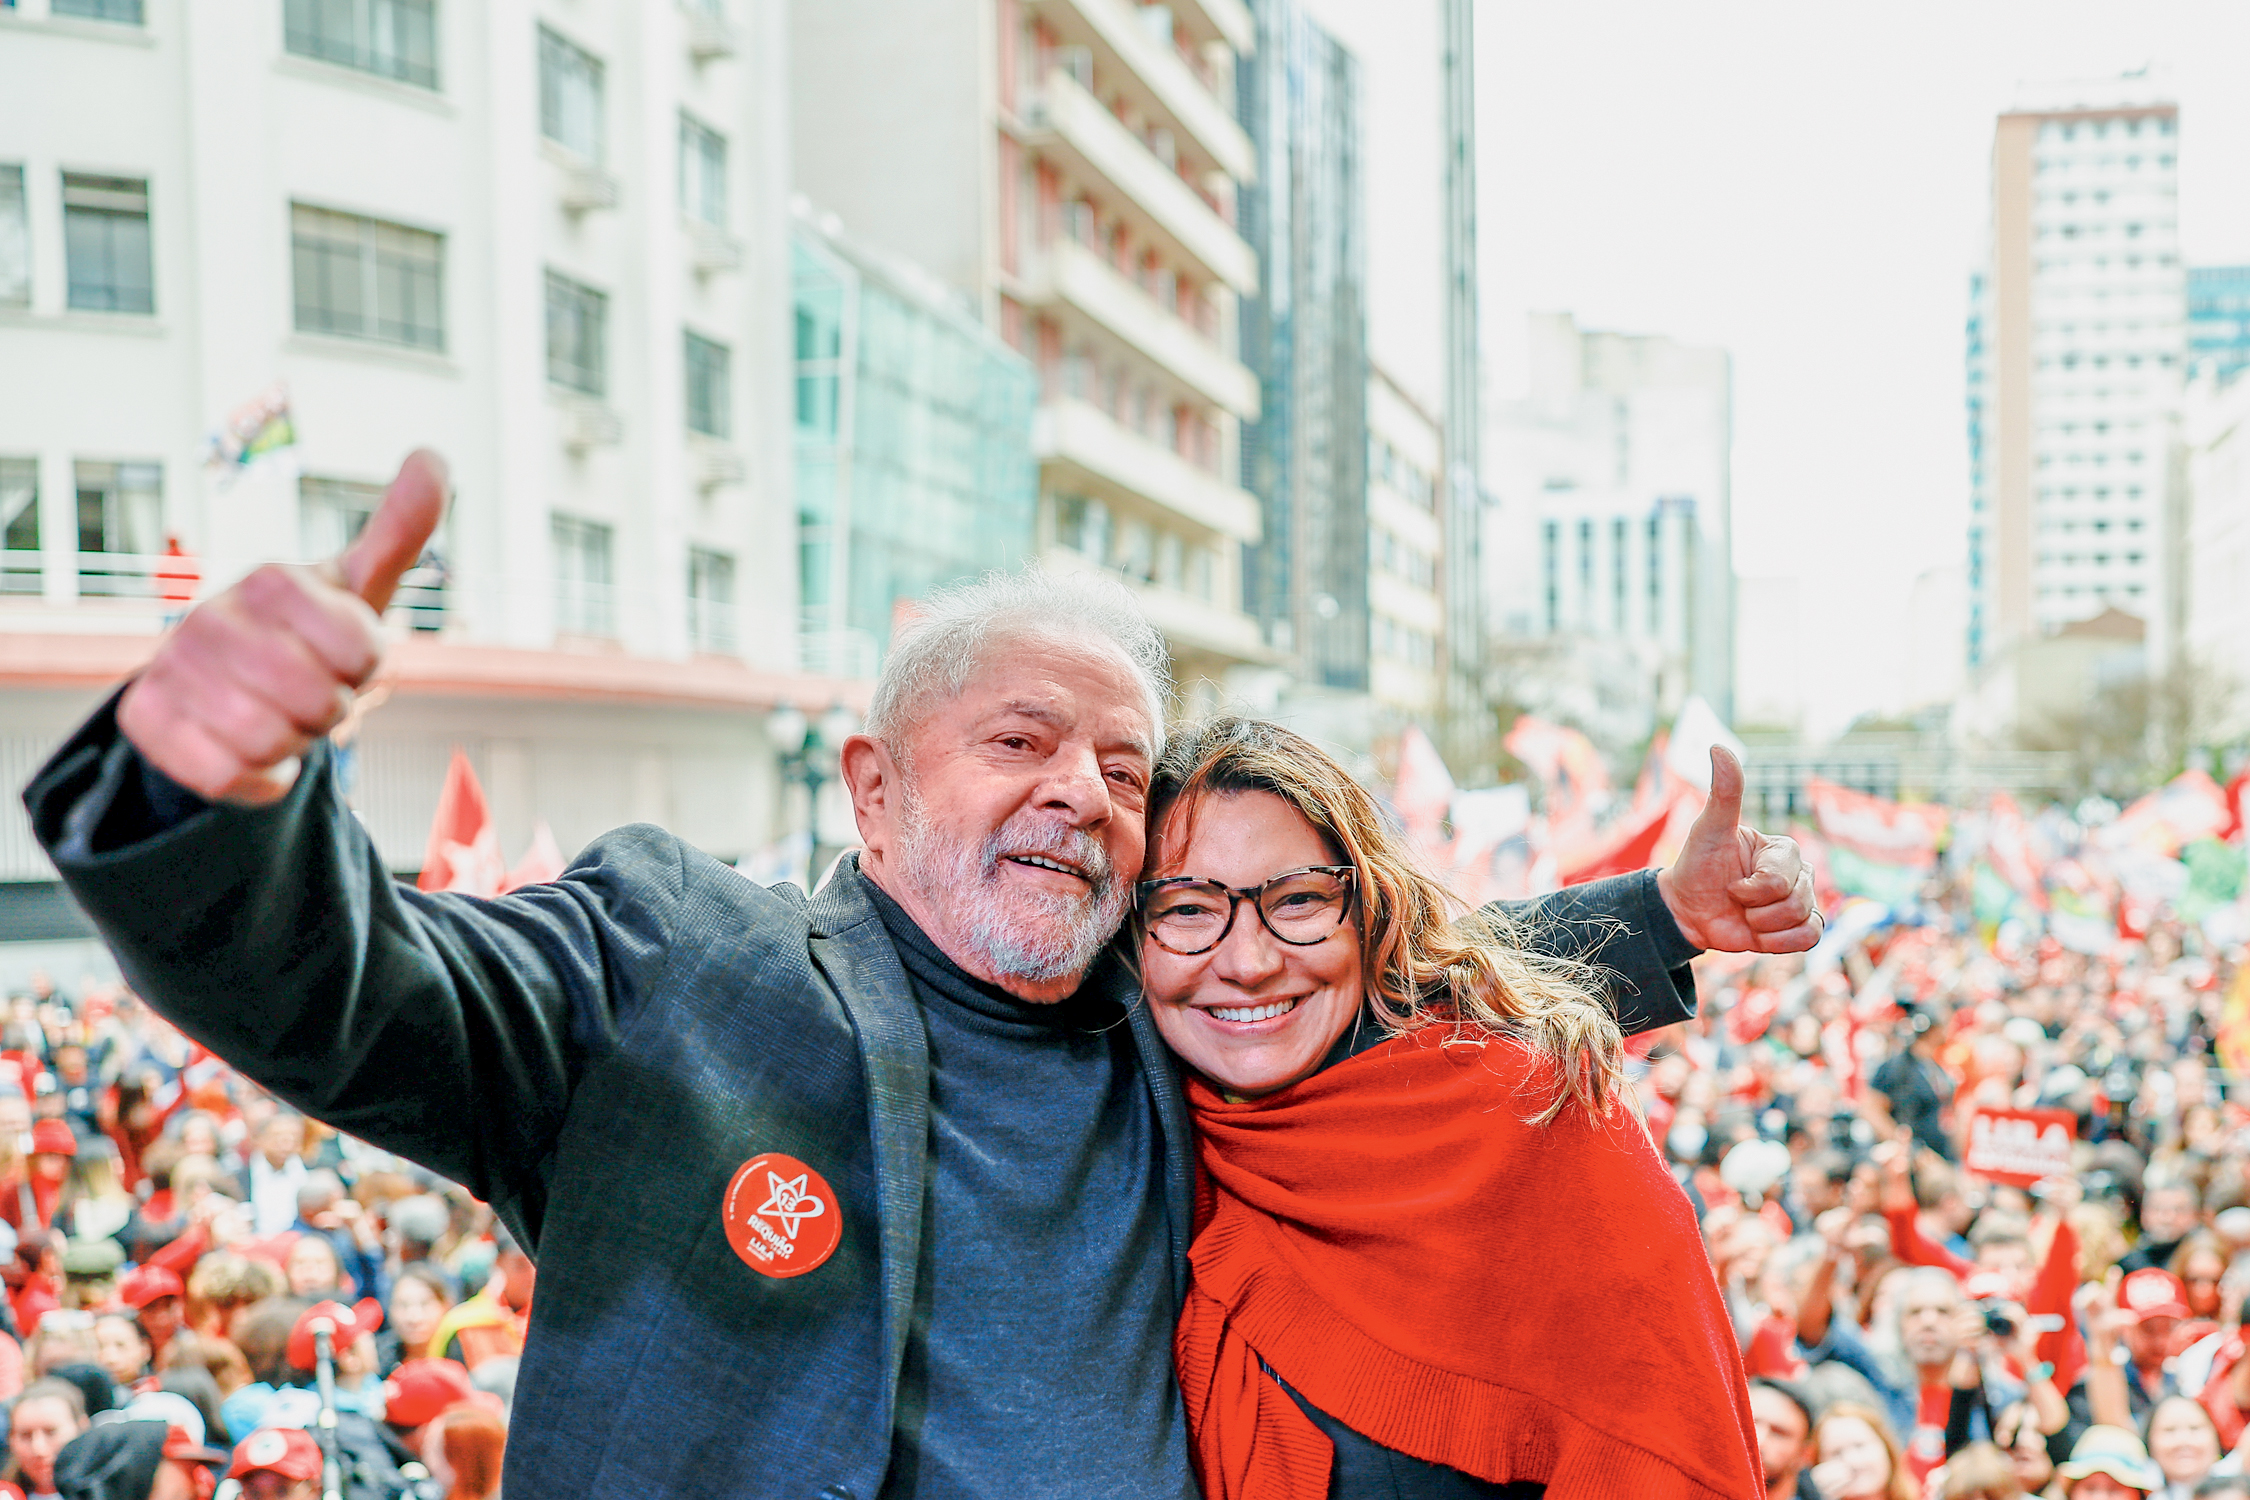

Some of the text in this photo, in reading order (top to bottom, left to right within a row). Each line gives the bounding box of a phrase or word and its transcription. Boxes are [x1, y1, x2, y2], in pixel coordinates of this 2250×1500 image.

[780, 1192, 798, 1212] 13
[747, 1214, 795, 1255] REQUIÃO
[749, 1237, 775, 1261] LULA
